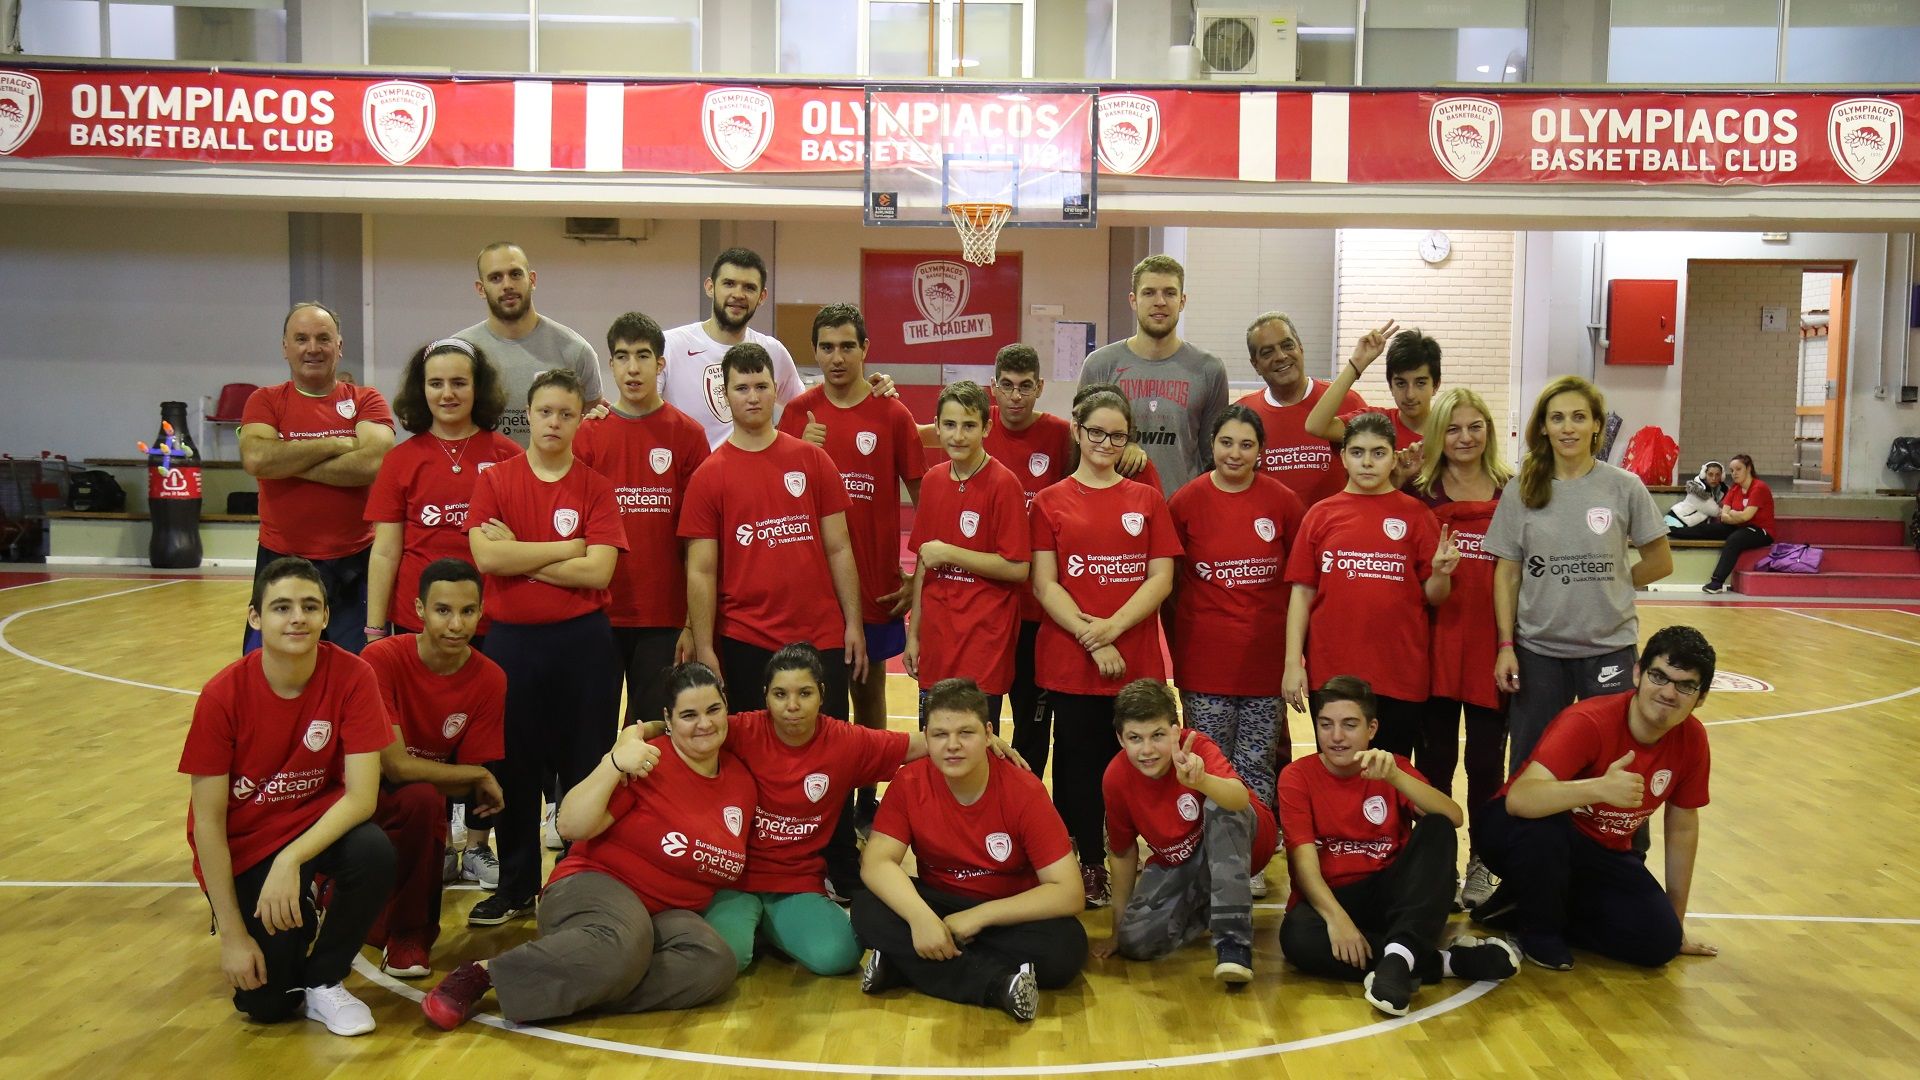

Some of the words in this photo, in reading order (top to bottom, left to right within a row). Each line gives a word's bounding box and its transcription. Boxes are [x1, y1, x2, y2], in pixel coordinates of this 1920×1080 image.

[373, 89, 426, 100] OLYMPIACOS
[71, 84, 335, 125] OLYMPIACOS
[712, 95, 765, 106] OLYMPIACOS
[1439, 104, 1493, 116] OLYMPIACOS
[1838, 106, 1895, 117] OLYMPIACOS
[802, 100, 1060, 138] OLYMPIACOS
[1447, 112, 1486, 121] BASKETBALL
[1845, 114, 1886, 122] BASKETBALL
[1531, 108, 1798, 144] OLYMPIACOS
[70, 123, 254, 151] BASKETBALL
[263, 128, 333, 153] CLUB
[1531, 148, 1715, 171] BASKETBALL
[1725, 149, 1797, 172] CLUB
[920, 265, 963, 276] OLYMPIACOS
[909, 324, 929, 339] THE
[933, 318, 984, 337] ACADEMY
[289, 430, 329, 438] Euroleague
[1265, 446, 1300, 454] Euroleague
[1266, 452, 1331, 465] oneteam
[1087, 554, 1123, 562] Euroleague
[1337, 550, 1375, 559] Euroleague
[1088, 561, 1146, 575] oneteam
[1214, 558, 1250, 567] Euroleague
[1337, 558, 1405, 573] oneteam
[1216, 564, 1277, 579] oneteam
[954, 575, 975, 583] AIRLINES
[1601, 665, 1619, 676] NIKE
[695, 839, 727, 855] Euroleague
